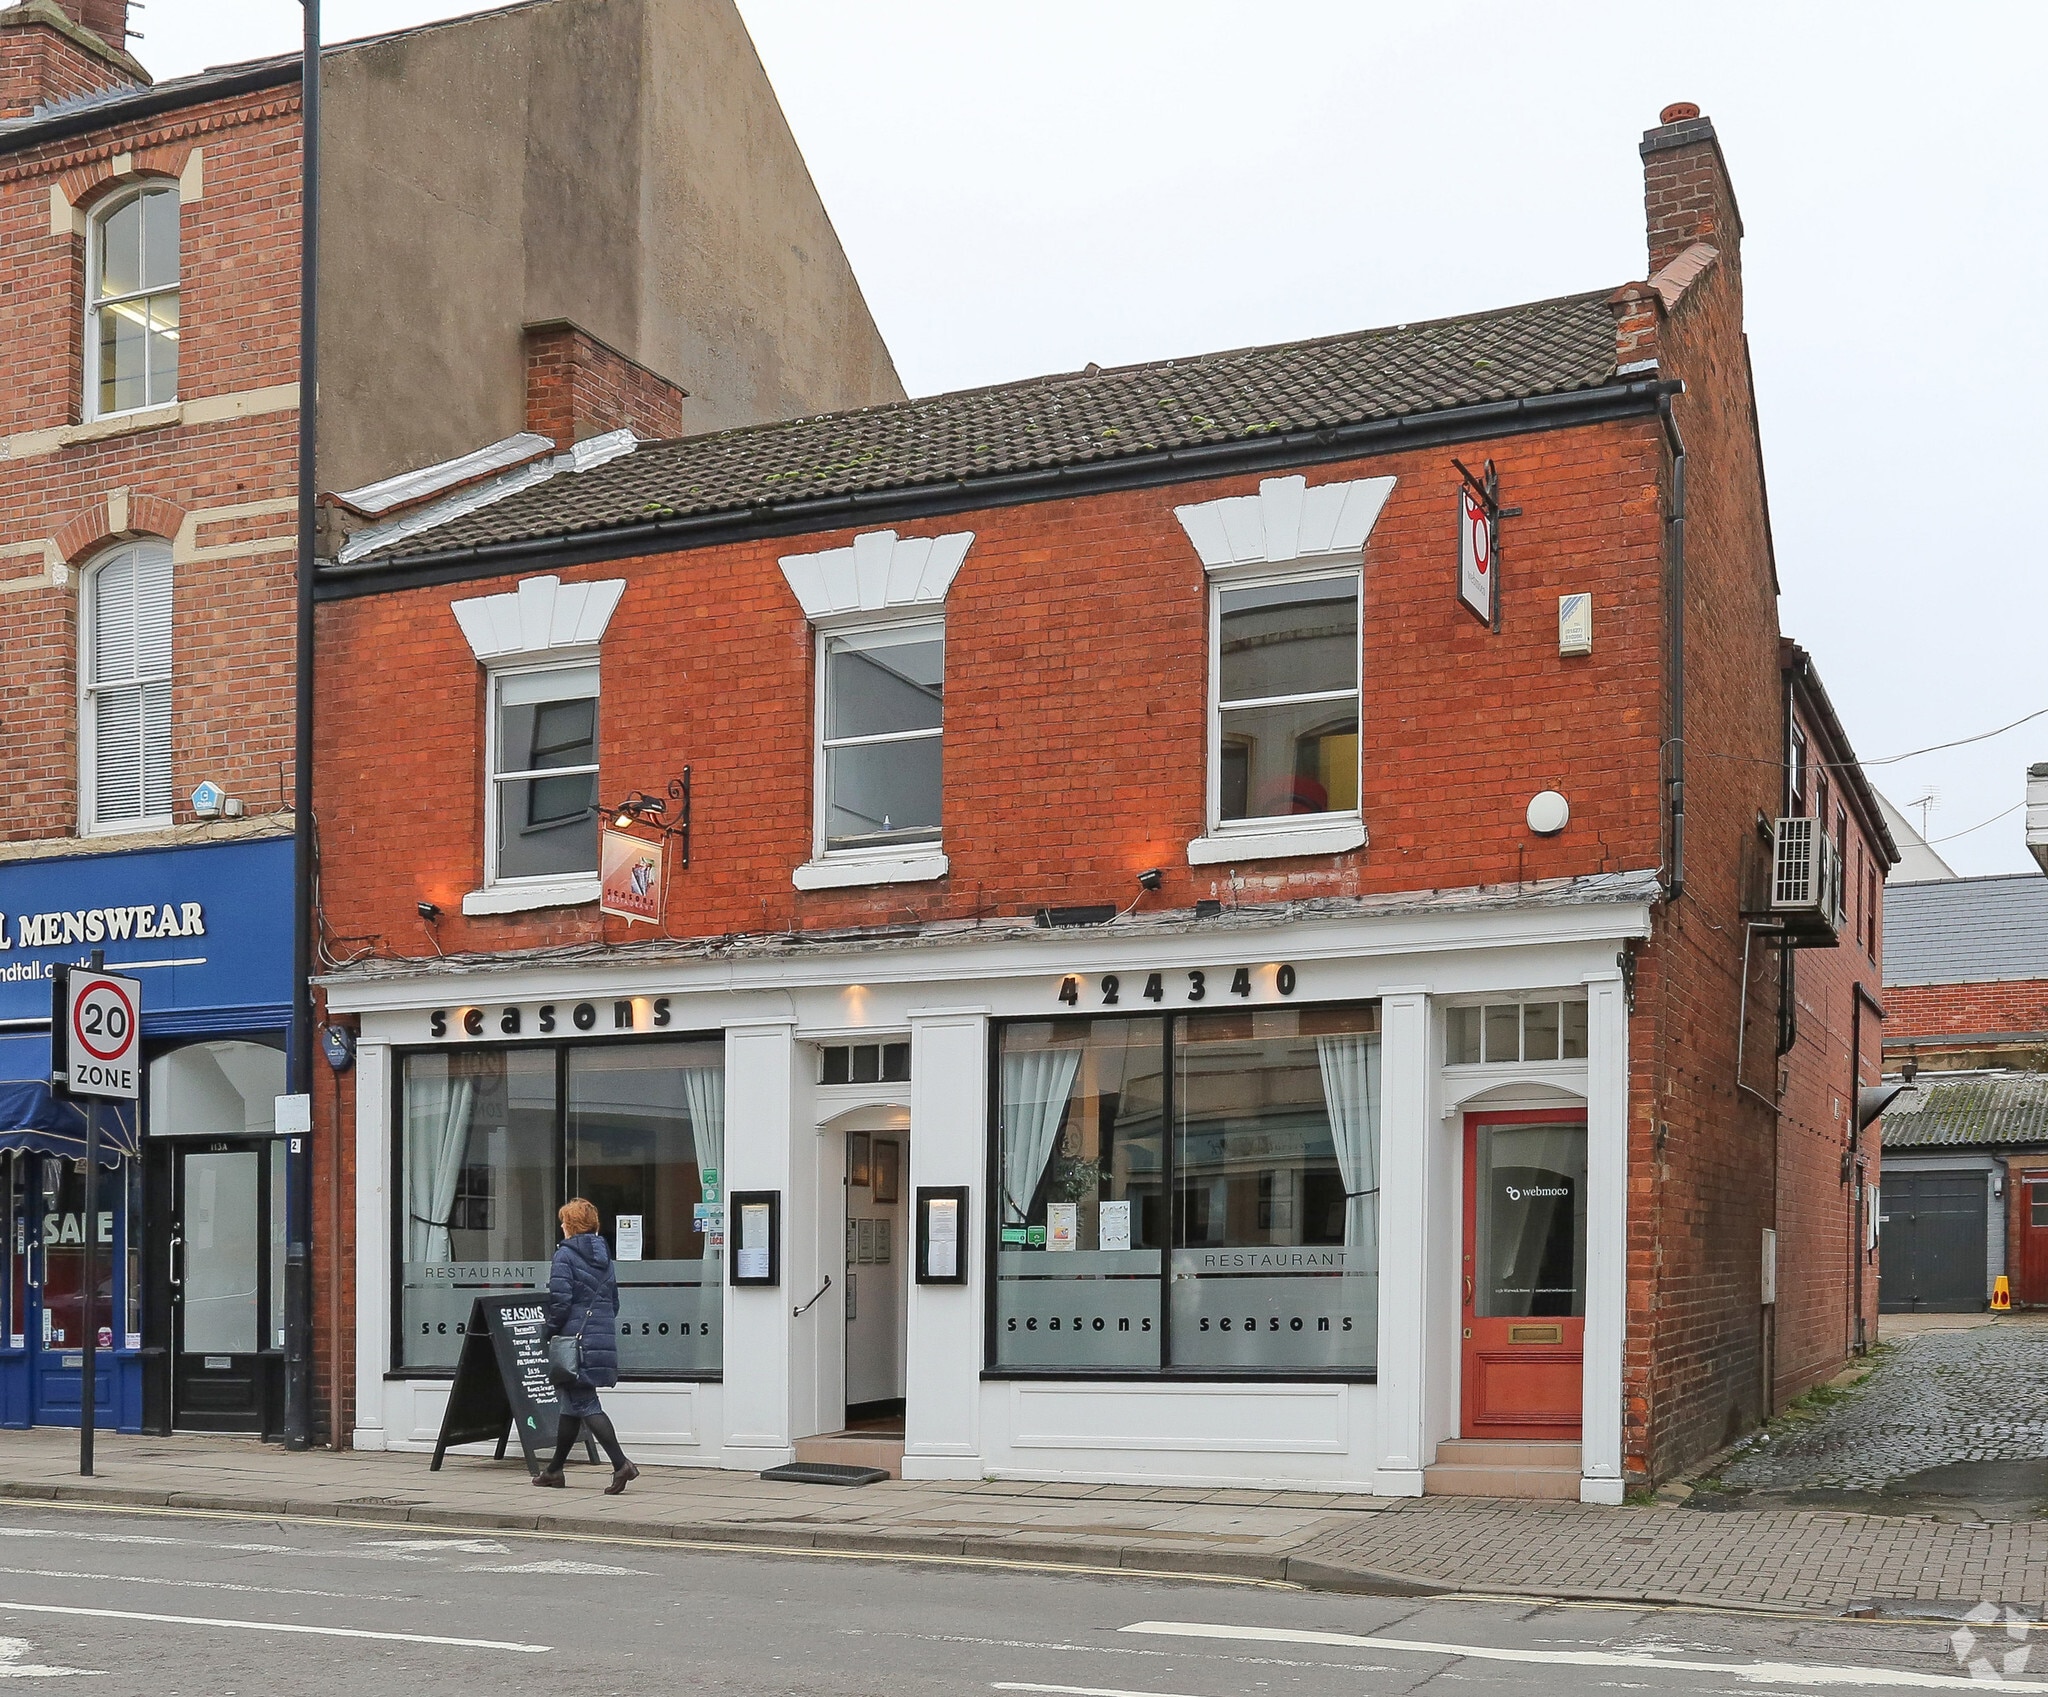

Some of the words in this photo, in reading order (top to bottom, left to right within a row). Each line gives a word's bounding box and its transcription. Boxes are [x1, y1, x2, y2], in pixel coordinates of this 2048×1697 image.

[18, 902, 205, 948] MENSWEAR
[1058, 964, 1296, 1006] 424340
[84, 1002, 126, 1038] 20
[430, 998, 671, 1037] seasons
[76, 1064, 132, 1090] ZONE
[1522, 1186, 1568, 1196] webmoco
[1204, 1252, 1349, 1268] RESTAURANT
[425, 1266, 537, 1279] RESTAURANT
[500, 1306, 544, 1320] SEASONS
[621, 1321, 710, 1337] asons
[1007, 1316, 1152, 1333] seasons
[1200, 1315, 1354, 1333] seasons
